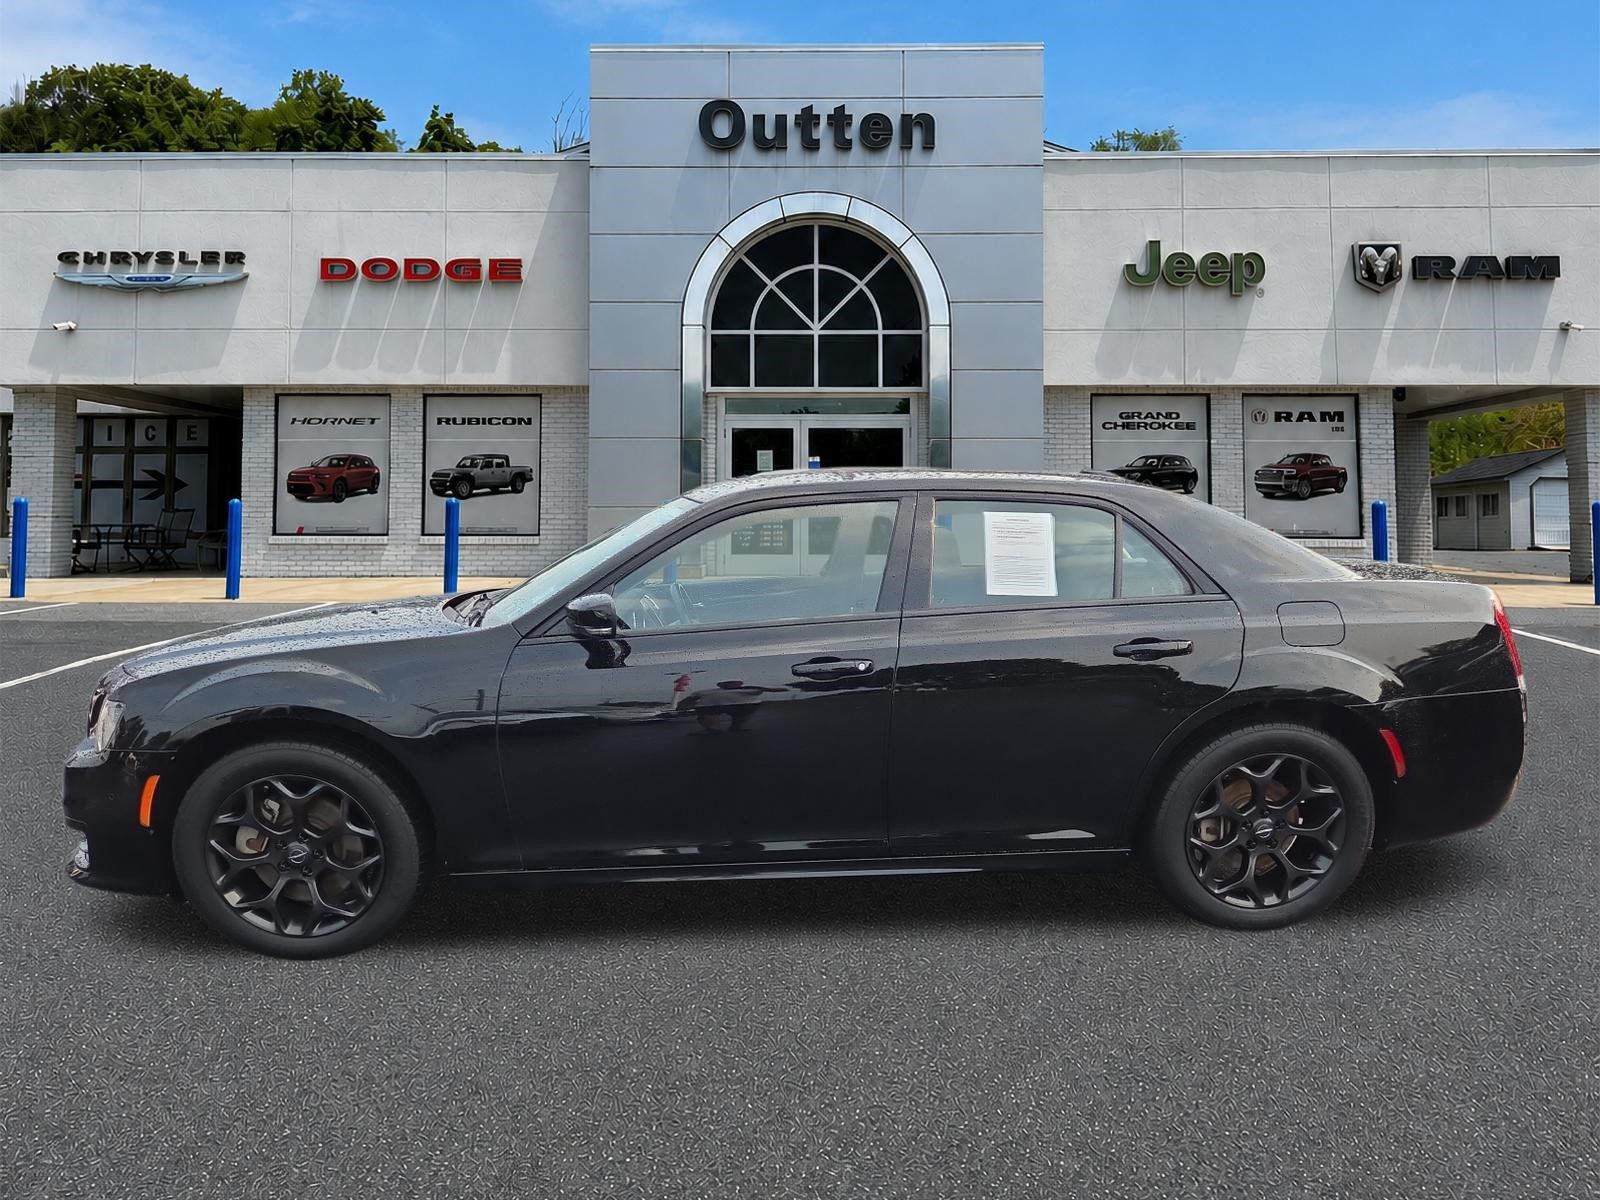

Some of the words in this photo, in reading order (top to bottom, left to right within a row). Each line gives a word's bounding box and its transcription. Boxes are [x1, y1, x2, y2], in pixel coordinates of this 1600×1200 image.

[699, 99, 936, 150] Outten
[57, 251, 246, 266] CHRYSLER
[320, 257, 524, 283] DODGE
[1124, 240, 1266, 296] Jeep
[1411, 256, 1561, 280] RAM
[290, 417, 381, 425] HORNET
[436, 417, 532, 426] RUBICON
[1118, 411, 1180, 420] GRAND
[1274, 411, 1344, 422] RAM
[1101, 421, 1196, 430] CHEROKEE
